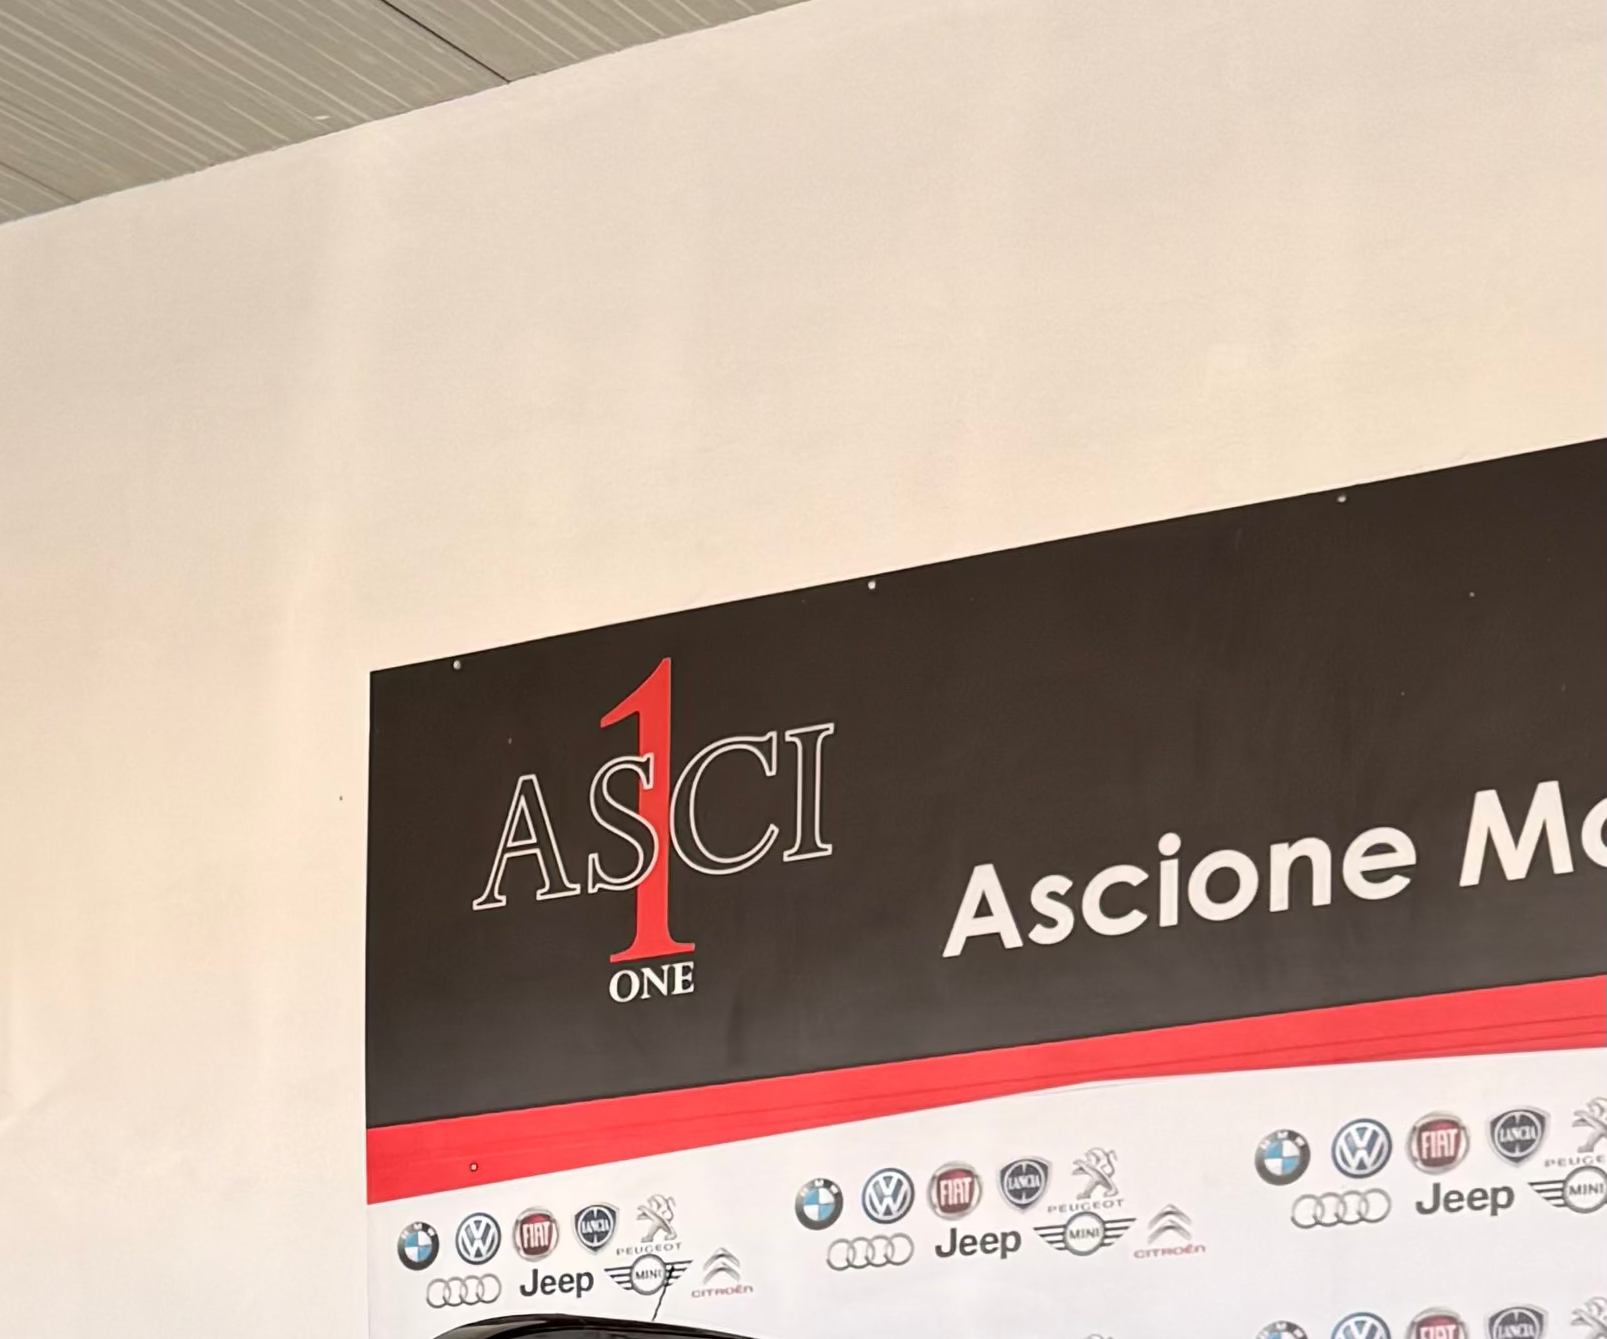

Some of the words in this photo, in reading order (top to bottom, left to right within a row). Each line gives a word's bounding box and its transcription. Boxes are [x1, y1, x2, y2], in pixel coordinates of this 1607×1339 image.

[472, 722, 834, 910] ASCI
[942, 826, 1417, 958] Ascione
[608, 961, 695, 1003] ONE
[1420, 1127, 1460, 1160] FIAT
[939, 1175, 973, 1208] FIAT
[1415, 1182, 1515, 1217] Jeep
[1568, 1183, 1604, 1195] MINI
[1047, 1198, 1125, 1214] PEUGEOT
[522, 1220, 553, 1249] FIAT
[616, 1242, 683, 1257] PEUGEOT
[935, 1228, 1022, 1260] Jeep
[1069, 1228, 1100, 1241] MINI
[520, 1268, 594, 1299] Jeep
